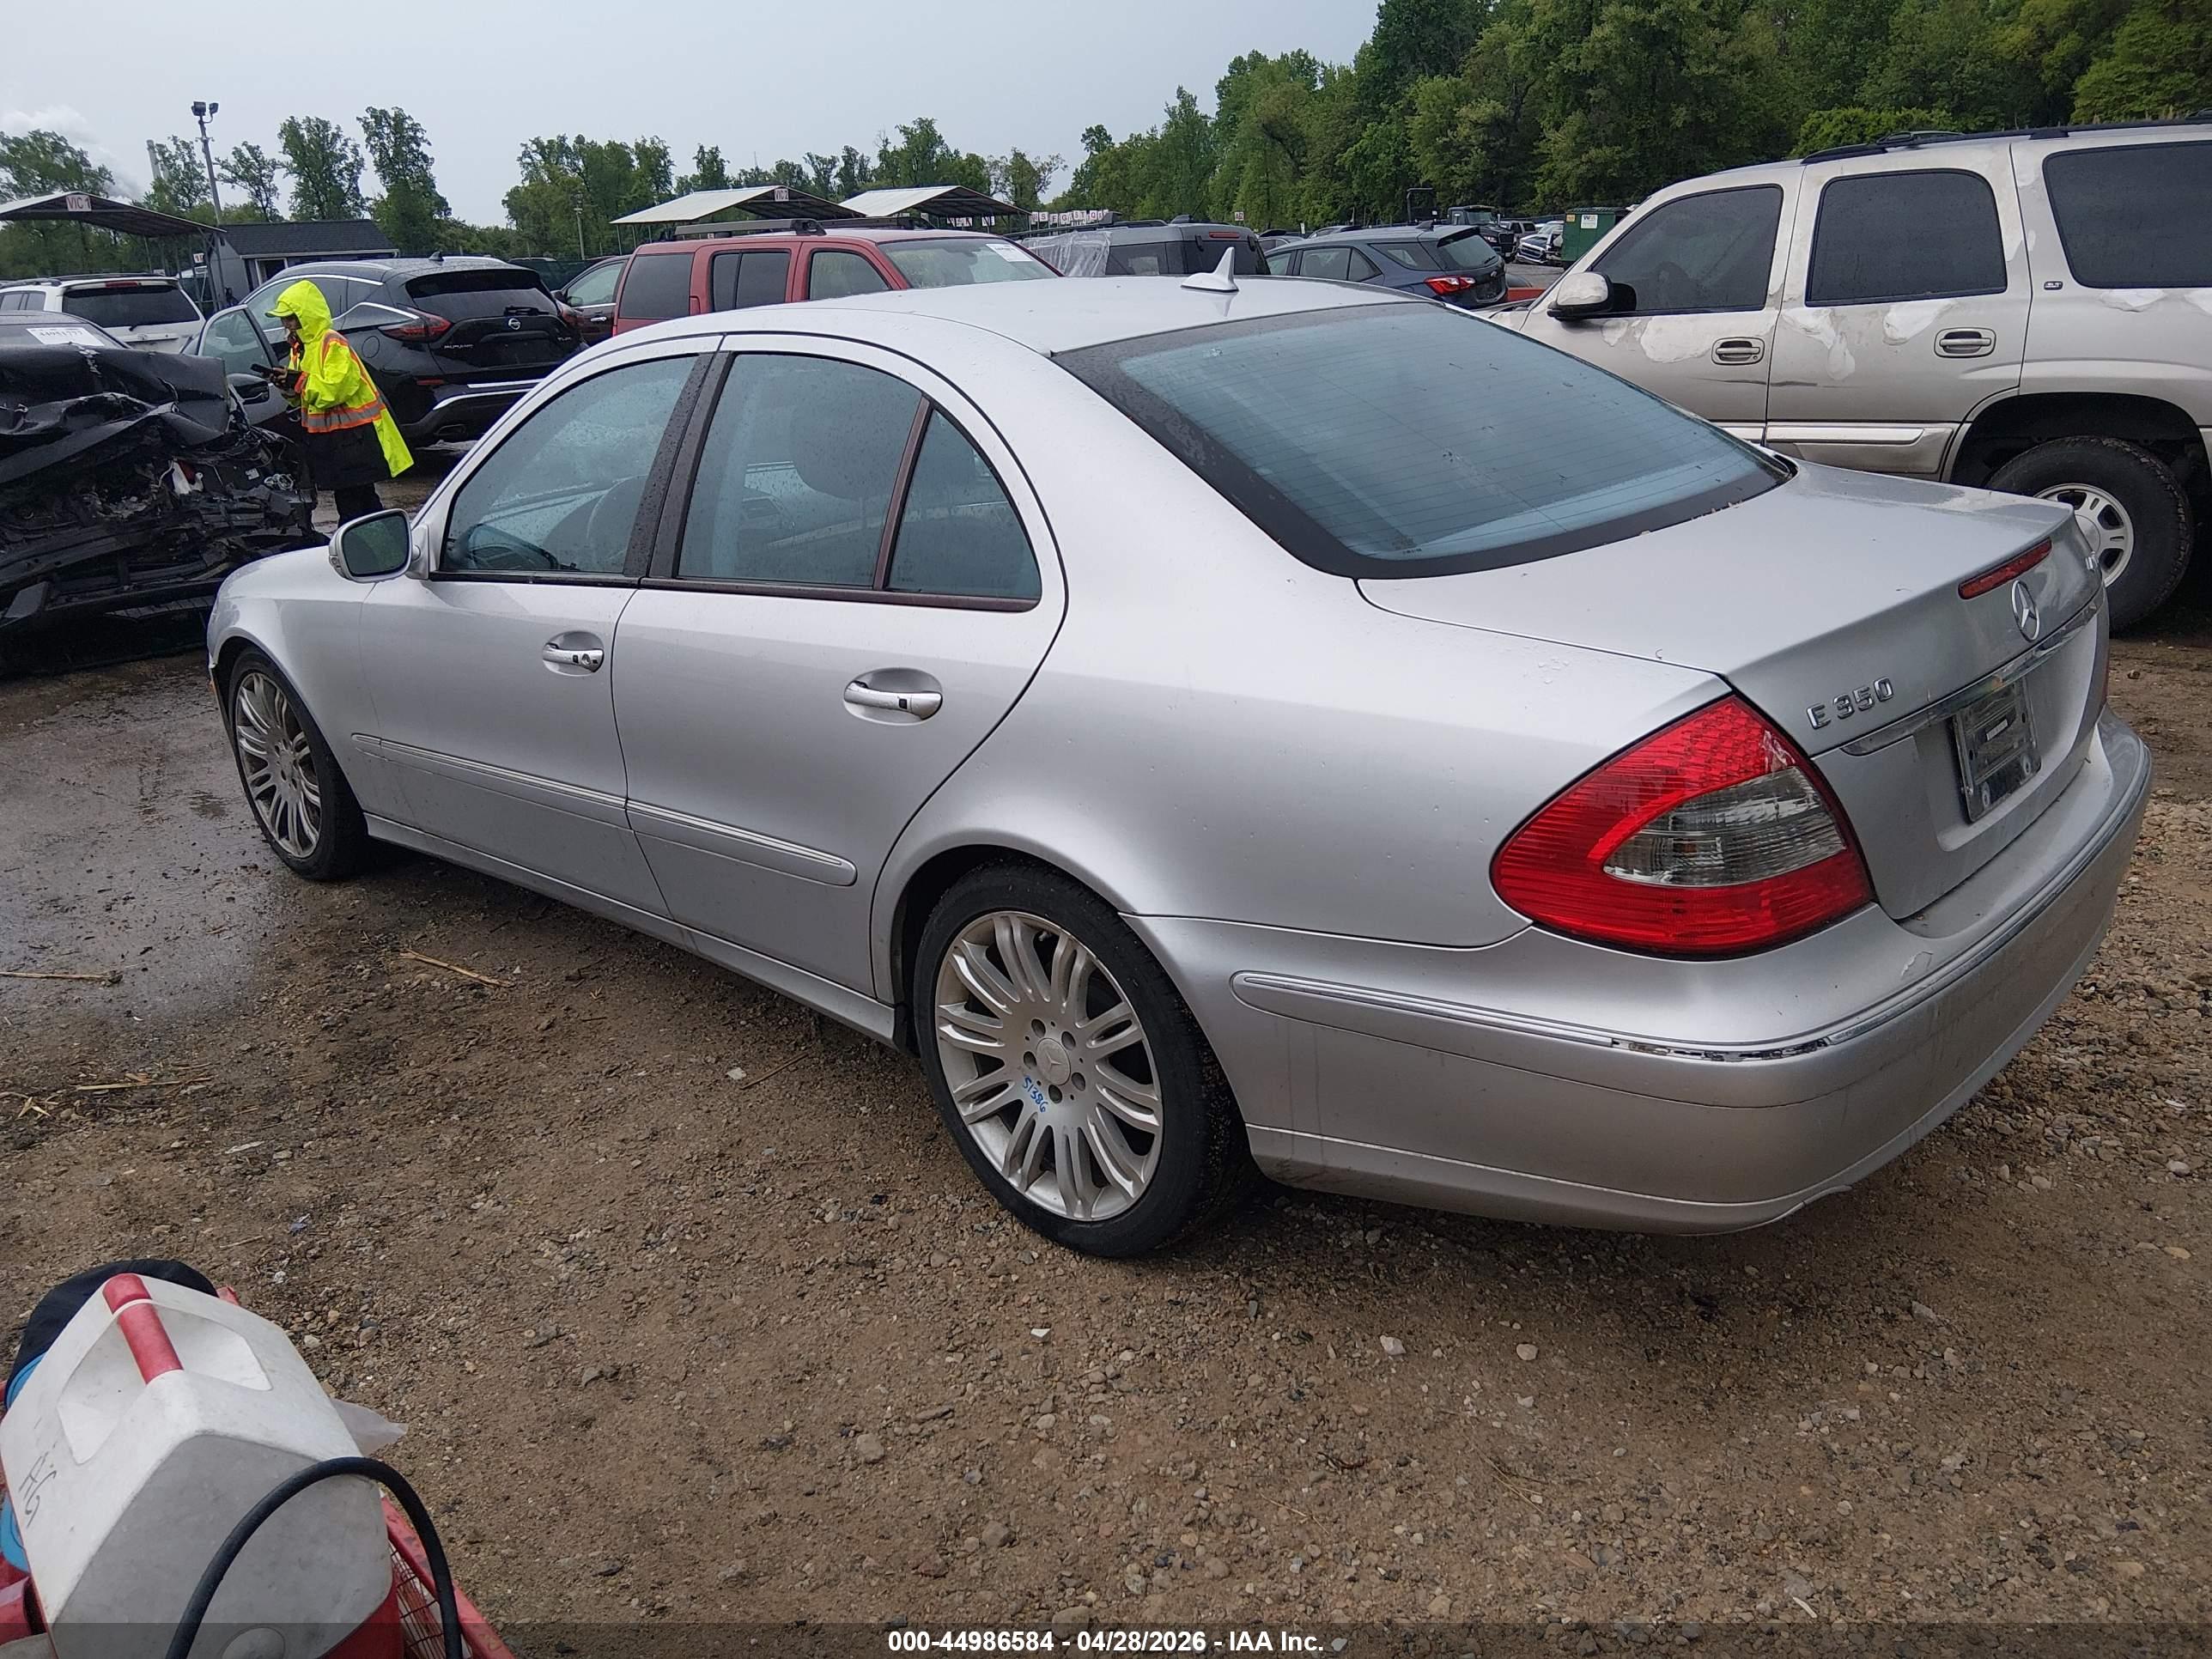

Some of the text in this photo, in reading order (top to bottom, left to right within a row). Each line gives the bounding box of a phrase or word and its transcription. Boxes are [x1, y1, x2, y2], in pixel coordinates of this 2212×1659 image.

[67, 197, 83, 210] VIC
[1807, 677, 1894, 730] E 350
